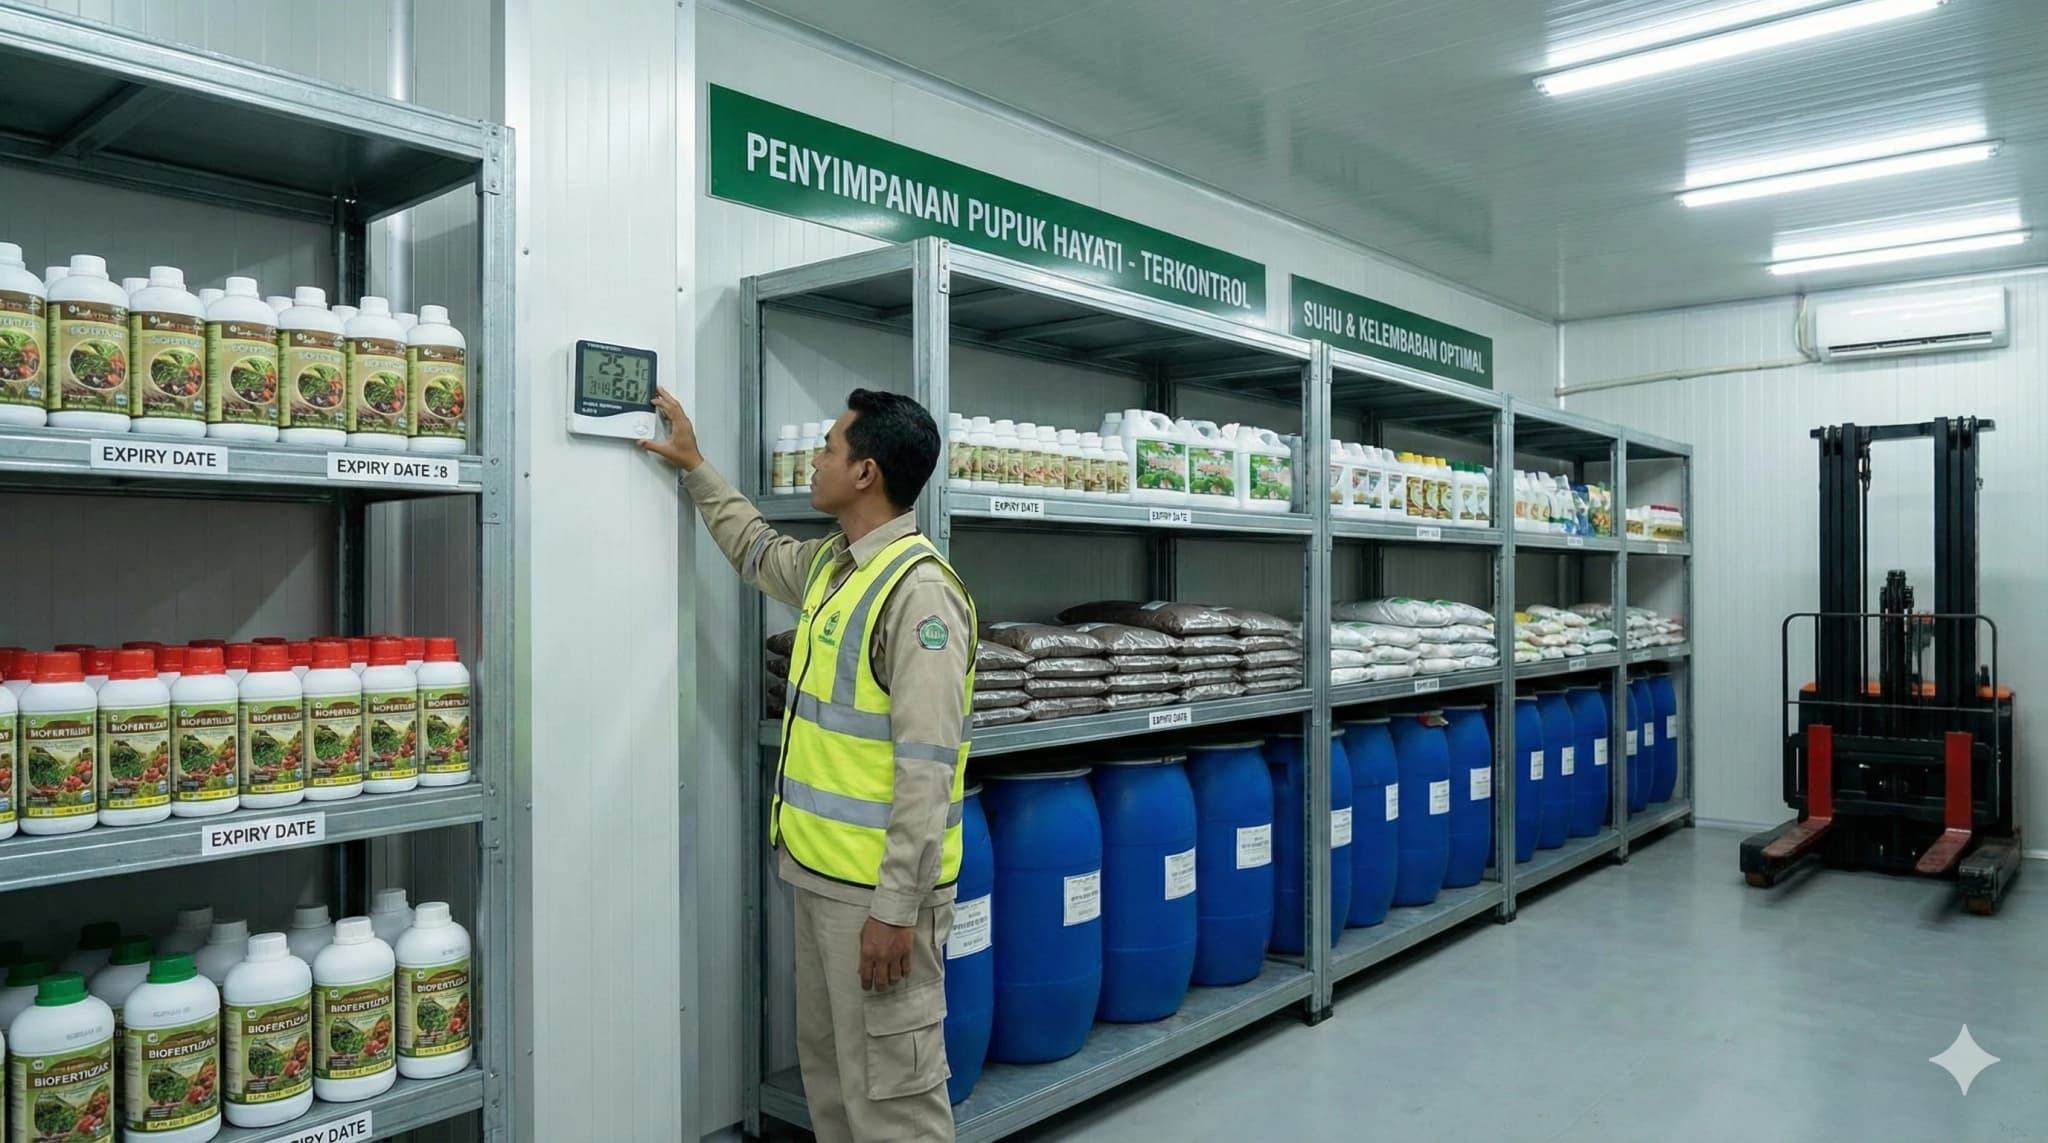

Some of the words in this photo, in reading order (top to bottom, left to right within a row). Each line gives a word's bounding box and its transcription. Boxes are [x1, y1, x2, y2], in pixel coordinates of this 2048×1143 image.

[747, 131, 960, 228] PENYIMPANAN
[968, 197, 1047, 252] PUPUK
[1053, 224, 1123, 273] HAYATI
[1141, 250, 1251, 310] TERKONTROL
[1304, 301, 1342, 335] SUHU
[1346, 313, 1356, 338] &
[1359, 316, 1437, 361] KELEMBABAN
[1440, 341, 1485, 374] OPTIMAL
[103, 446, 167, 464] EXPIRY
[173, 450, 217, 467] DATE
[337, 459, 390, 475] EXPIRY
[394, 462, 431, 478] DATE
[211, 825, 271, 847] EXPIRY
[275, 820, 316, 839] DATE
[328, 1119, 366, 1143] DATE
